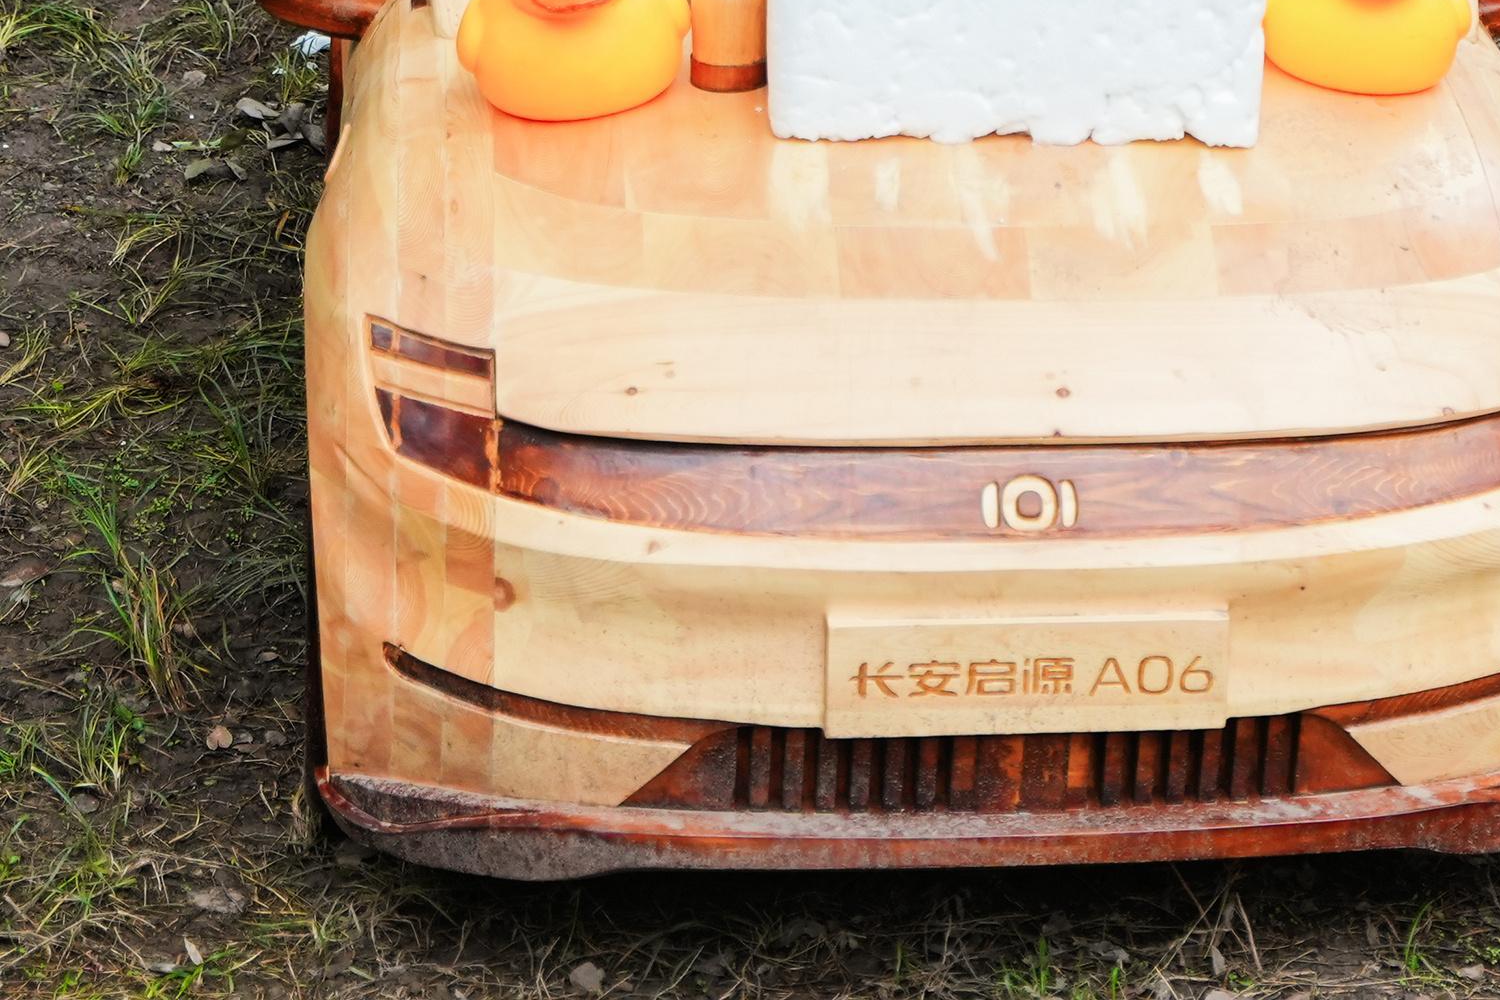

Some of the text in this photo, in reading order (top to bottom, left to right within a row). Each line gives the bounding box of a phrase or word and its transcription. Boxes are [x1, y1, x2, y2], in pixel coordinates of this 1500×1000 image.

[849, 654, 1215, 700] 长安启源 A06
